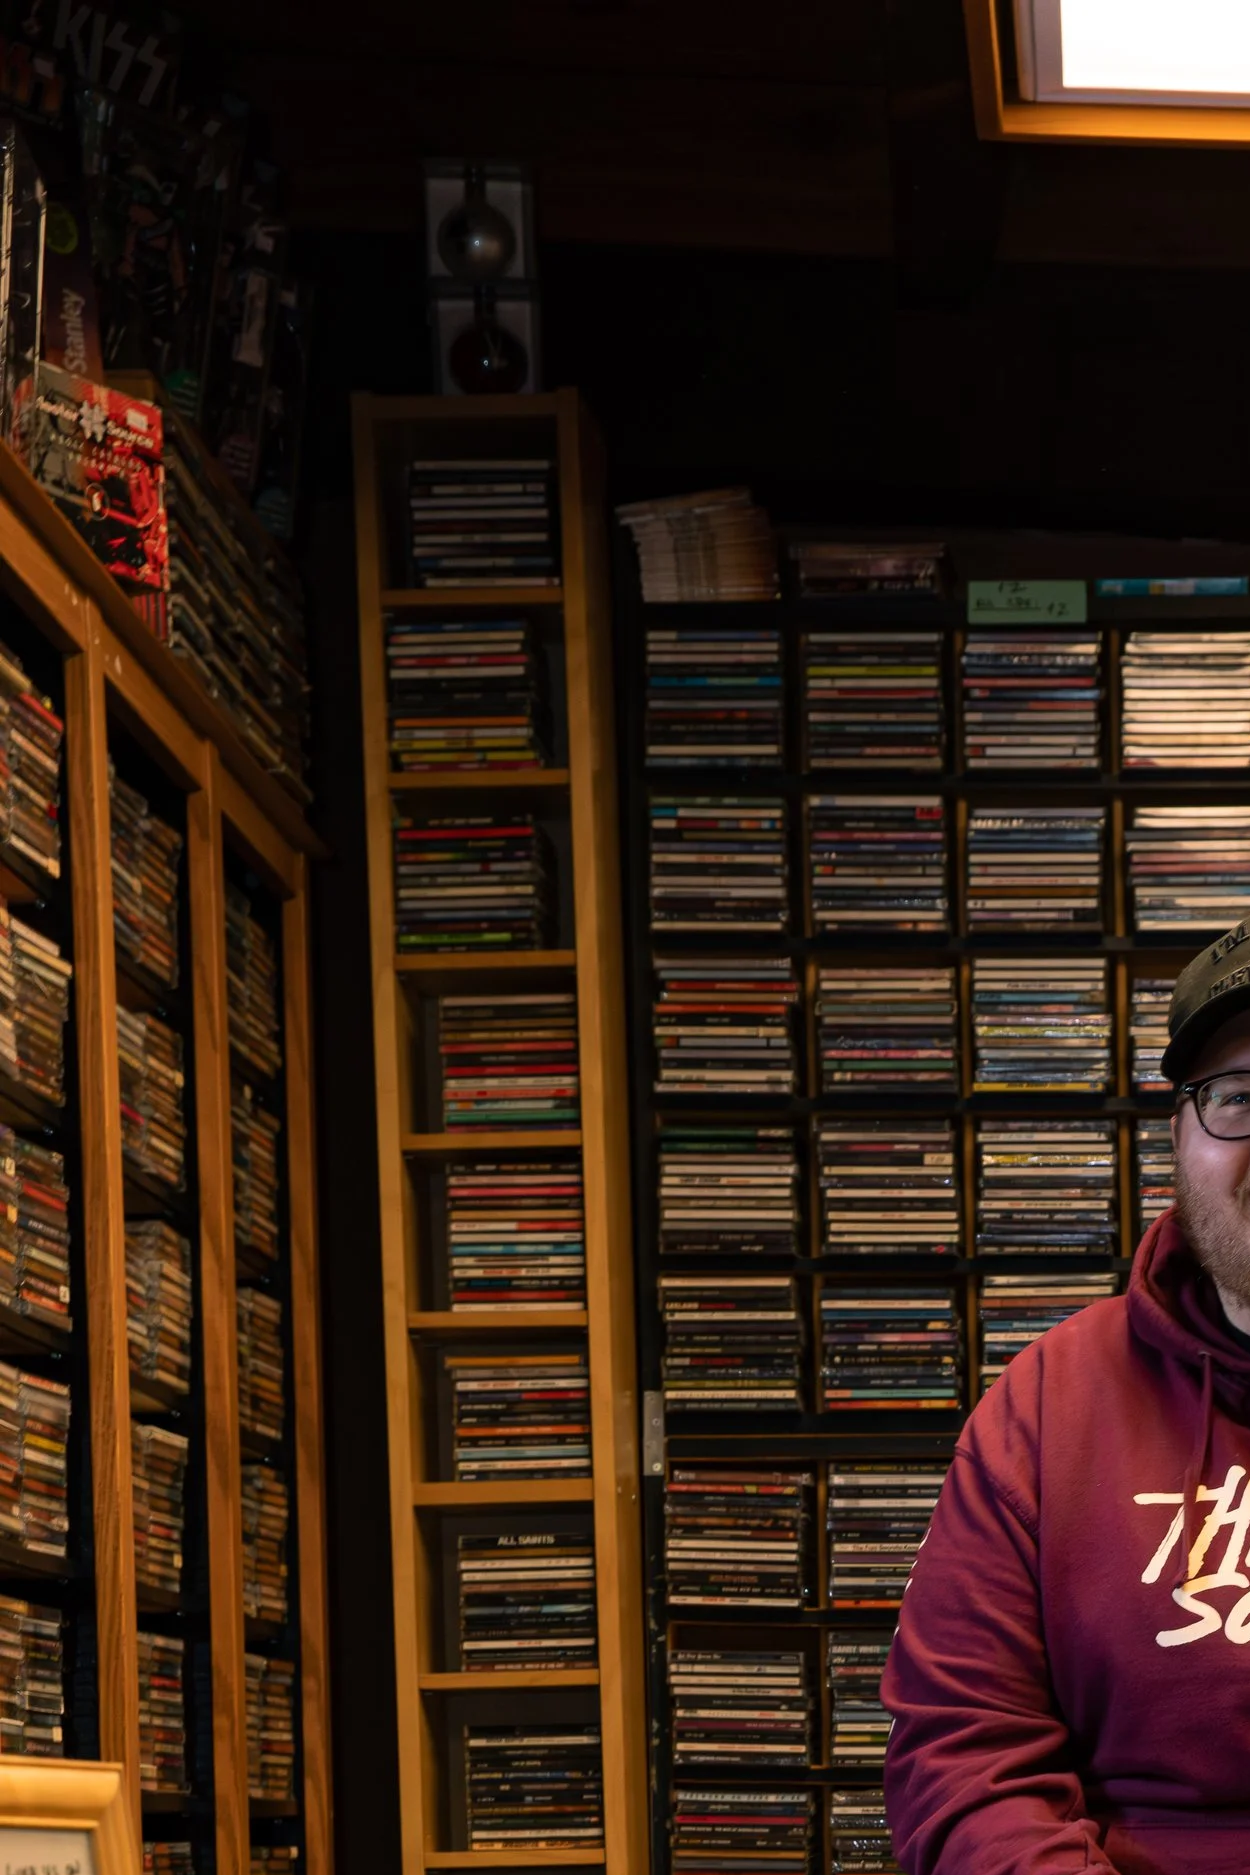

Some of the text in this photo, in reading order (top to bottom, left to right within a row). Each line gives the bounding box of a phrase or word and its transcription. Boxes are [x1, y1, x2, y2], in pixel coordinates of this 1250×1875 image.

[51, 0, 168, 107] KISS
[61, 288, 88, 373] Stanley
[497, 1535, 517, 1546] ALL
